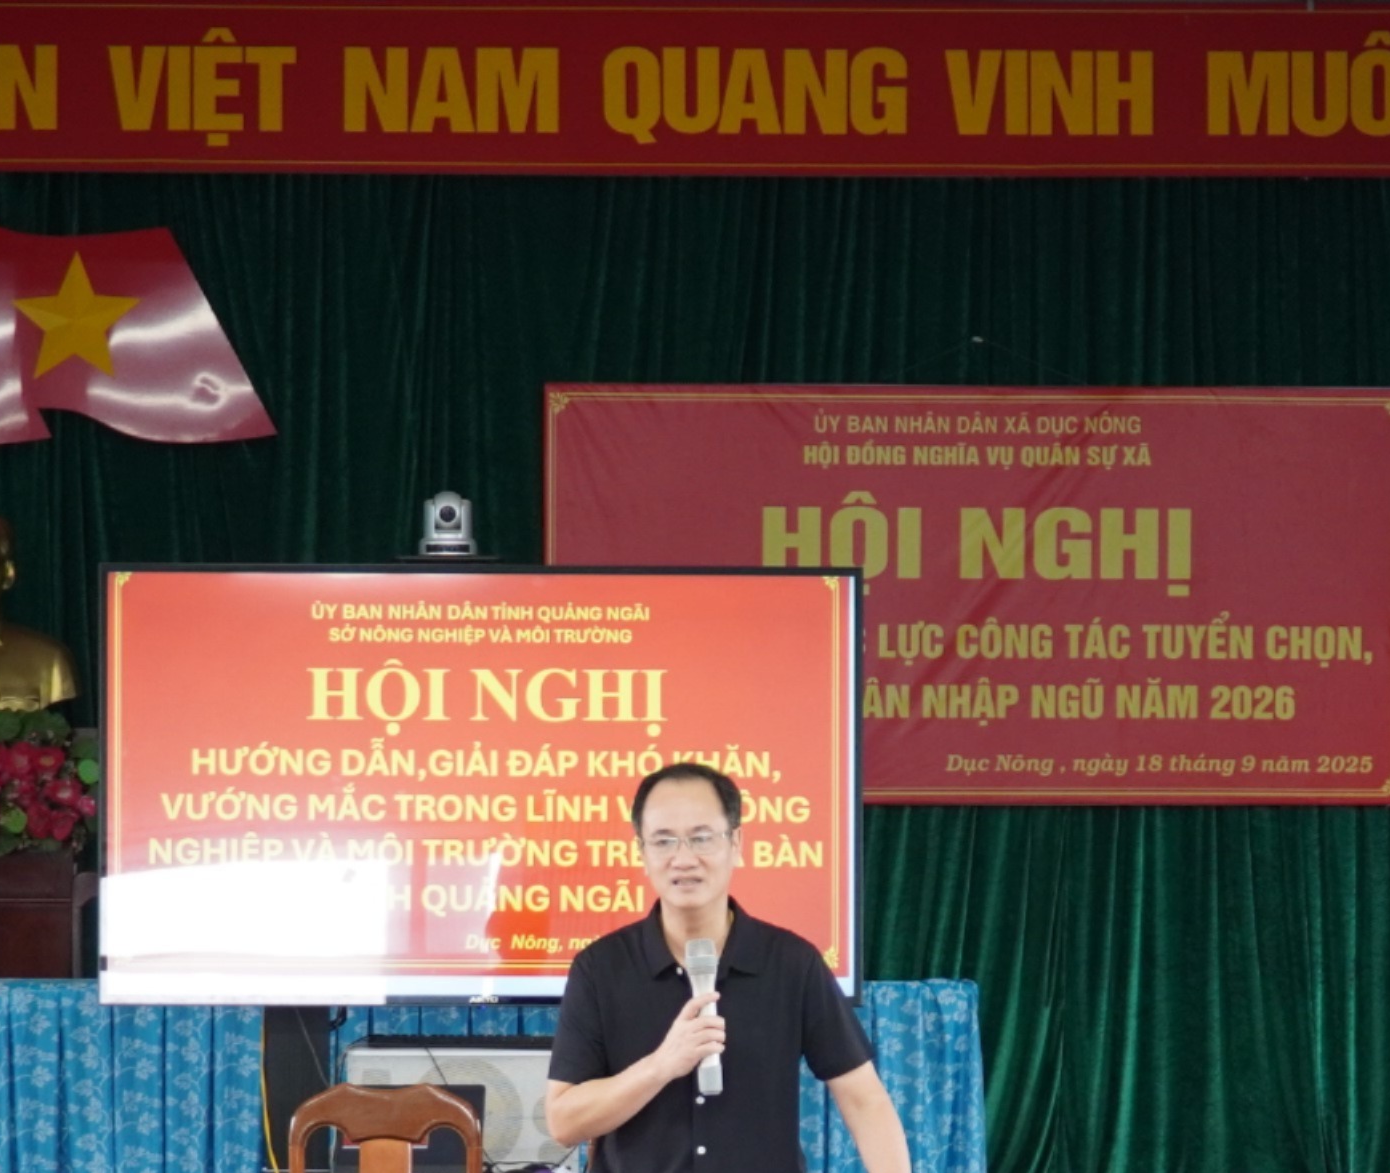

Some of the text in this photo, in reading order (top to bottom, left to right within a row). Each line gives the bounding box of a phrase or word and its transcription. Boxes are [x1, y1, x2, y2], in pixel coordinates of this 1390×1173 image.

[109, 28, 296, 147] VIỆT
[344, 47, 558, 133] NAM
[602, 46, 907, 143] QUANG
[947, 49, 1153, 137] VINH
[814, 408, 1141, 437] ỦY BAN NHÂN DÂN XÃ DỤC NÔNG
[804, 442, 838, 469] HỘI
[913, 443, 979, 465] NGHĨA
[987, 445, 1013, 470] VỤ
[1021, 443, 1080, 467] QUÂN
[1087, 444, 1118, 470] SỰ
[1123, 443, 1152, 466] XÃ
[762, 491, 1191, 596] HỘI NGHỊ
[311, 600, 650, 622] ỦY BAN NHÂN DÂN TỈNH QUẢNG NGÃI
[329, 624, 632, 646] SỞ NÔNG NGHIỆP VÀ MÔI TRƯỜNG
[878, 621, 944, 665] LỰC
[957, 617, 1052, 659] CÔNG
[1064, 617, 1130, 659] TÁC
[1142, 611, 1253, 659] TUYỂN
[1266, 626, 1373, 667] CHỌN,
[306, 658, 667, 737] HỘI NGHỊ
[922, 677, 1296, 726] NHẬP NGŨ NĂM 2026
[191, 742, 332, 776] HƯỚNG
[507, 743, 579, 777] ĐÁP
[587, 743, 662, 777] KHÓ
[946, 754, 1373, 776] Dục Nông ngày 18 tháng 9 năm 2025
[160, 787, 297, 821] VƯỚNG
[308, 782, 387, 821] MẮC
[394, 794, 517, 821] TRONG
[527, 789, 608, 822] LĨNH
[346, 833, 414, 866] MÔI
[422, 836, 578, 868] TRƯỜNG
[753, 833, 823, 867] BÀN
[560, 878, 644, 913] NGÃI
[511, 933, 563, 954] Nông,
